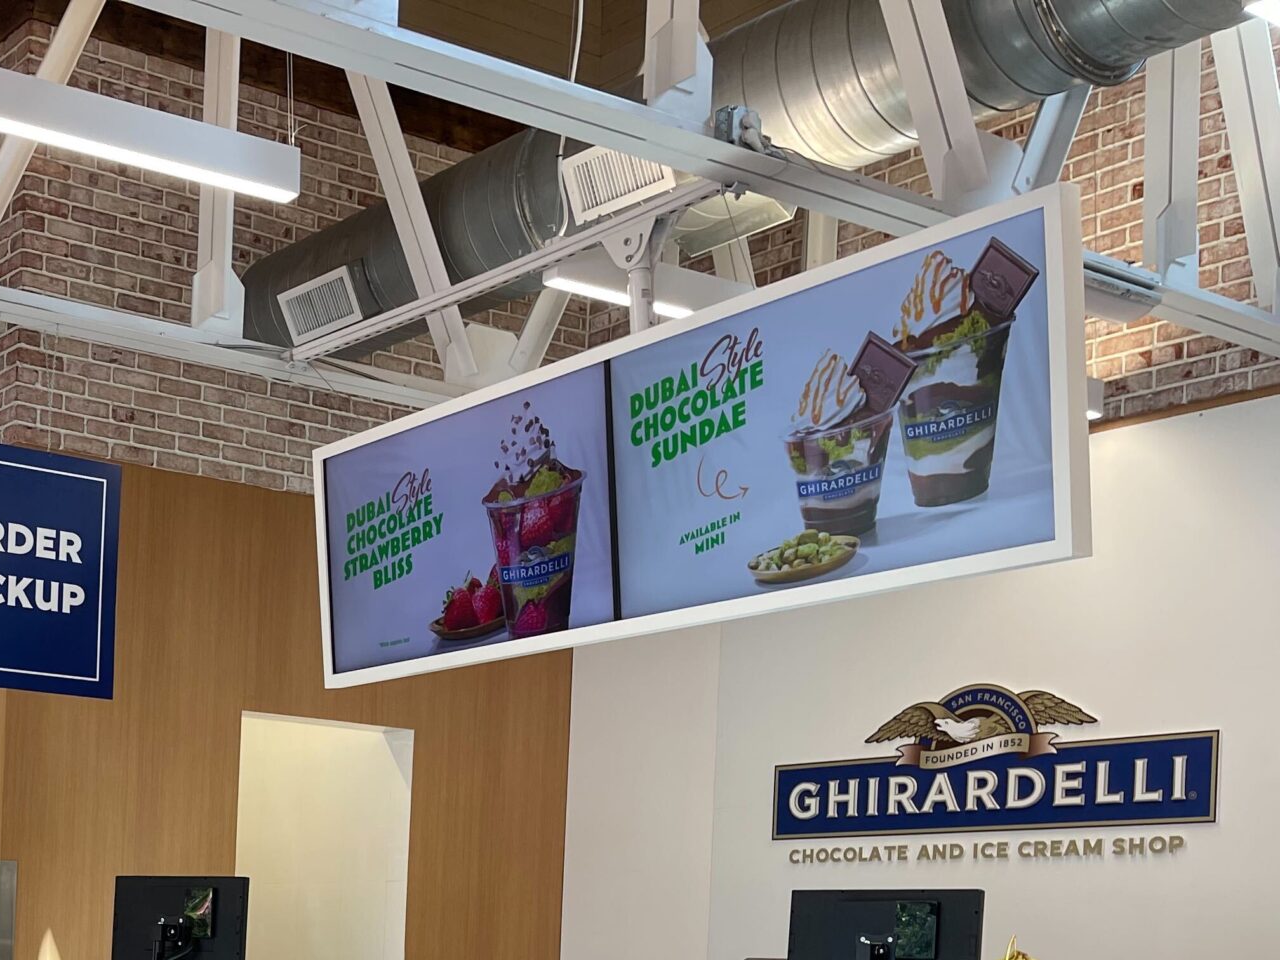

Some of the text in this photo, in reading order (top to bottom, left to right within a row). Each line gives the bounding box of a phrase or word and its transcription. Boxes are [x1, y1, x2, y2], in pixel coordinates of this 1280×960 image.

[629, 327, 763, 420] DUBAI Style
[630, 360, 764, 447] CHOCOLATE
[906, 406, 992, 437] GHIRARDELLI
[651, 401, 746, 468] SUNDAE
[799, 467, 880, 495] GHIRARDELLI
[346, 468, 432, 534] DUBAI Style
[346, 493, 433, 555] CHOCOLATE
[679, 511, 741, 545] AVAILABLE IN
[344, 512, 444, 581] STRAWBERRY
[695, 531, 725, 555] MINI
[373, 553, 413, 590] BLISS
[502, 556, 569, 581] GHIRARDELLI
[951, 692, 1026, 729] SAN FRANCISCO
[925, 738, 1023, 764] FOUNDED IN 1852
[788, 755, 1188, 821] GHIRARDELLI
[788, 835, 1185, 865] CHOCOLATE AND ICE CREAM SHOP
